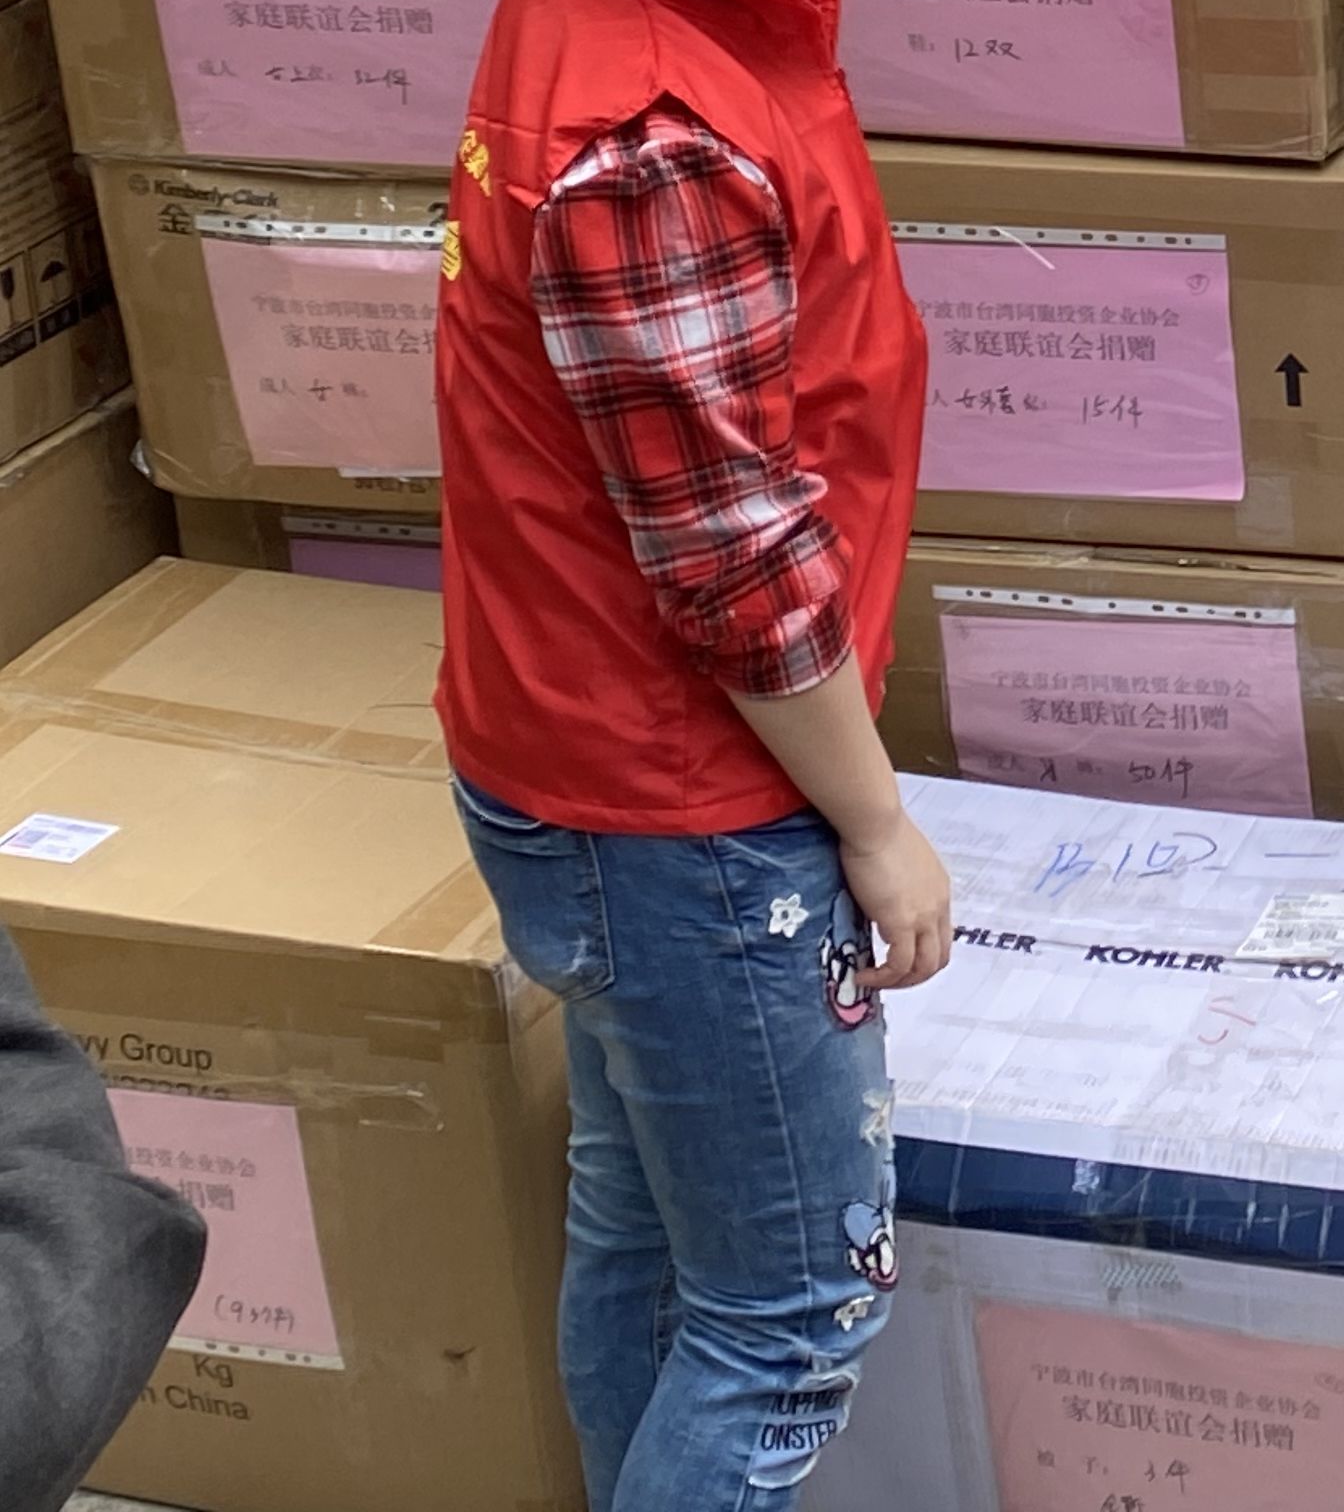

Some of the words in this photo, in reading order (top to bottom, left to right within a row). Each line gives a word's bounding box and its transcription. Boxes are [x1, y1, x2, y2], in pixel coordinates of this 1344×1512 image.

[224, 2, 433, 35] 家庭联谊会捐赠
[915, 299, 1180, 328] 宁波市台湾同胞投资企业协会
[944, 328, 1156, 362] 家庭联谊会捐赠
[1022, 698, 1229, 731] 家庭联谊会捐赠
[954, 926, 1038, 954] HLER
[1085, 945, 1225, 974] KOHLER
[120, 1032, 213, 1071] Group
[127, 1145, 257, 1179] 投资企业协会
[165, 1384, 250, 1421] China
[1030, 1363, 1322, 1421] 宁波市台湾同胞投资企业协会
[1061, 1394, 1295, 1451] 家庭联谊会捐赠
